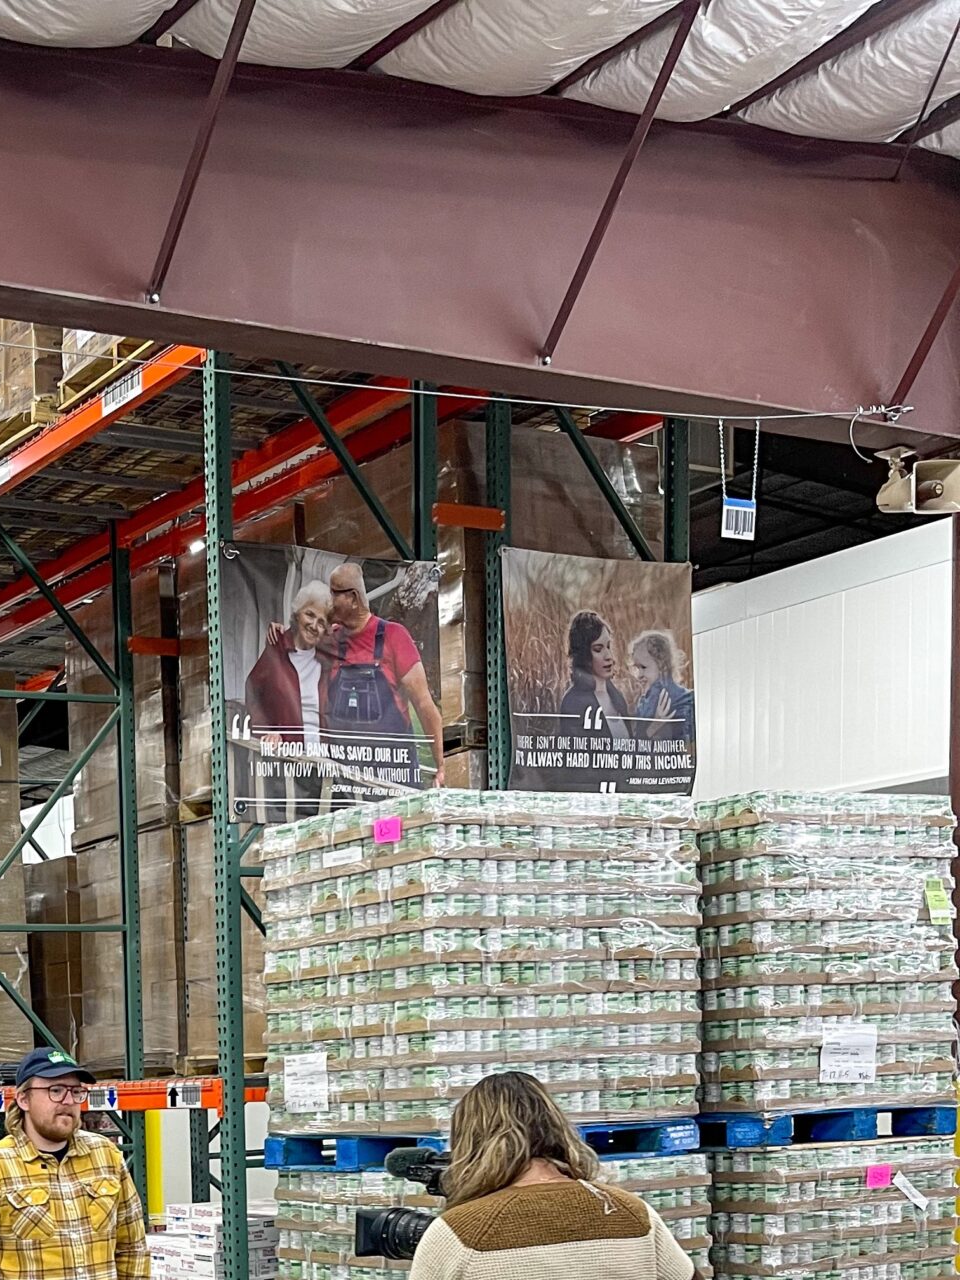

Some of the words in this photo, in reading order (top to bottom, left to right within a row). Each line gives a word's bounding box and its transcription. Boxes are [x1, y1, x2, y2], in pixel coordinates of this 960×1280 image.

[260, 741, 274, 757] THE
[277, 741, 303, 757] FOOD
[306, 742, 329, 758] BANK
[330, 744, 344, 760] HAS
[346, 746, 372, 762] SAVED
[374, 748, 391, 763] OUR
[393, 749, 411, 764] LIFE.
[536, 735, 555, 749] ISN'T
[557, 736, 571, 750] ONE
[573, 737, 588, 750] TIME
[590, 737, 611, 752] THAT'S
[613, 738, 636, 752] HARDER
[638, 739, 651, 752] THAN
[653, 740, 688, 753] ANOTHER.
[526, 751, 563, 767] ALWAYS
[566, 752, 590, 768] HARD
[592, 754, 619, 769] LIVING
[621, 755, 633, 769] ON
[635, 755, 651, 770] THIS
[654, 755, 695, 770] INCOME.
[250, 762, 254, 777] I
[256, 762, 281, 778] DON'T
[283, 762, 314, 778] KNOW
[316, 763, 340, 778] WHAT
[342, 766, 361, 780] WE'D
[363, 767, 375, 781] DO
[377, 768, 411, 784] WITHOUT
[413, 769, 424, 784] IT.
[629, 777, 642, 785] MOM
[642, 777, 657, 785] FROM
[331, 784, 352, 793] SENIOR
[353, 786, 371, 795] COUPLE
[372, 787, 388, 797] FROM
